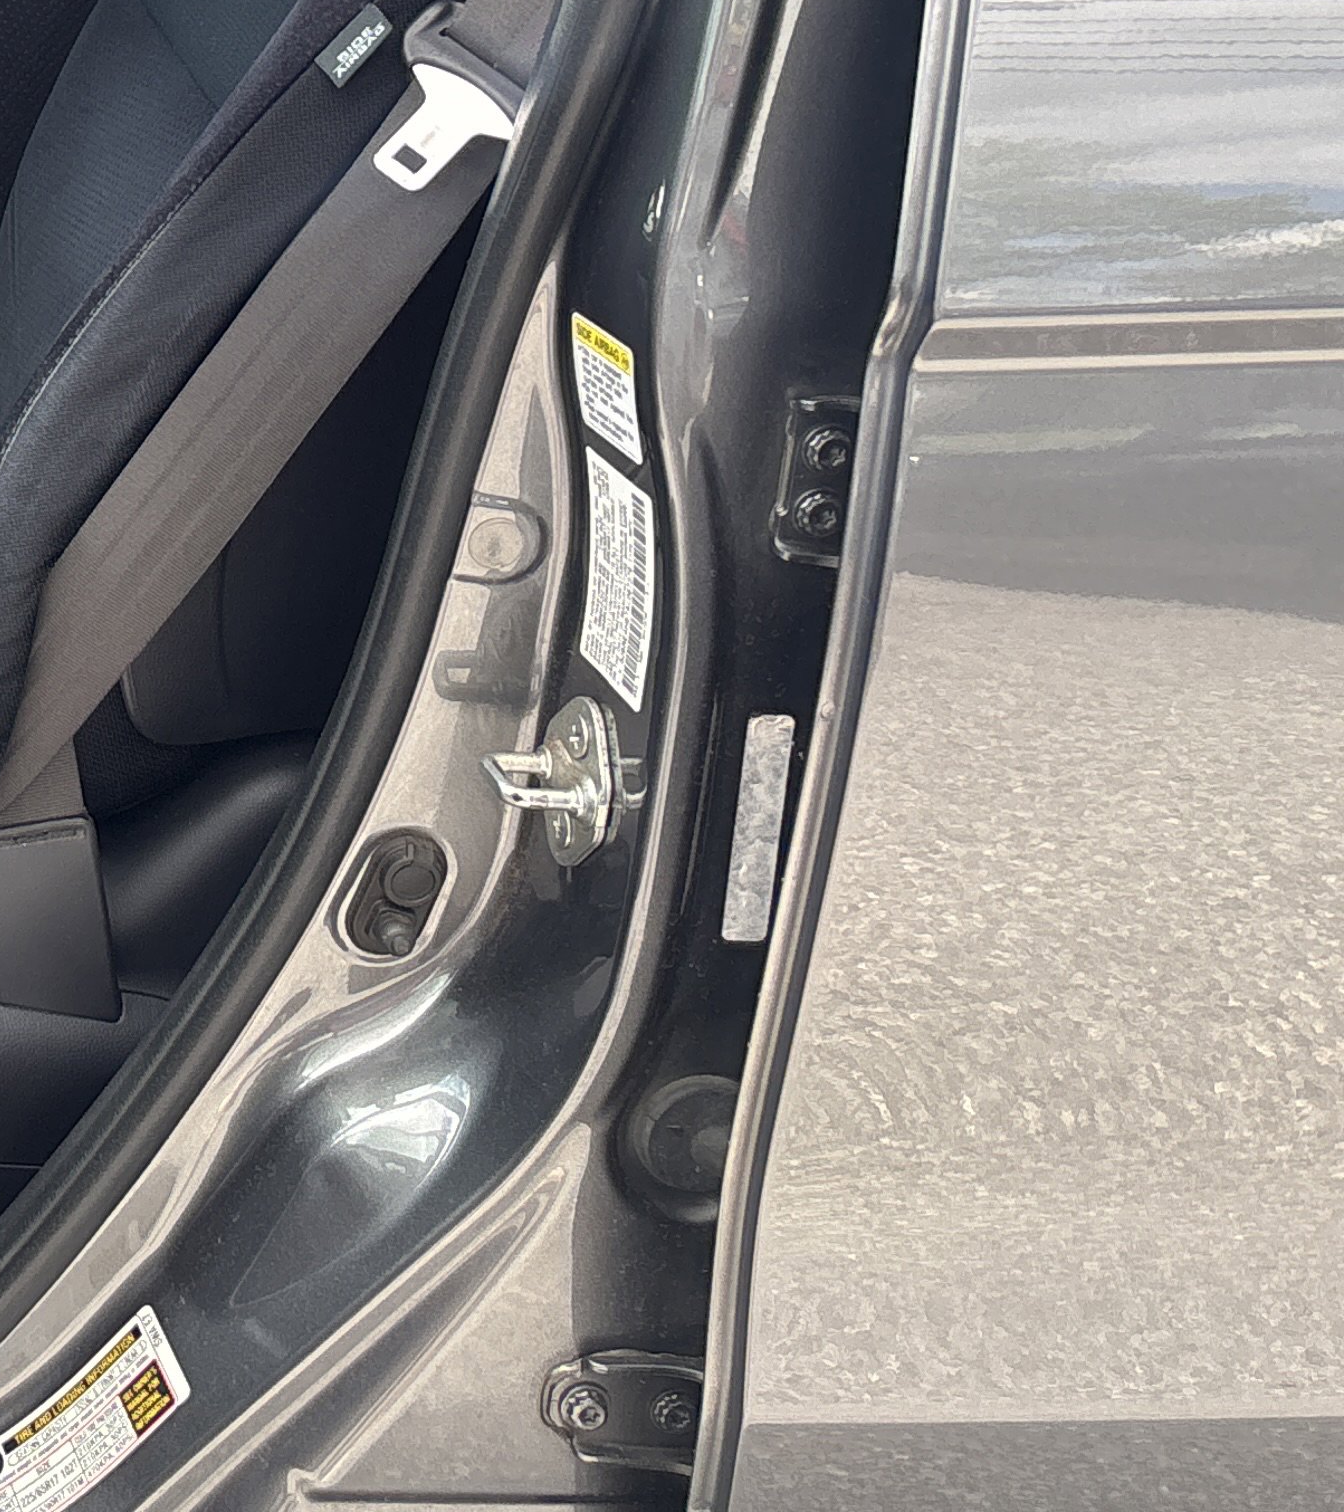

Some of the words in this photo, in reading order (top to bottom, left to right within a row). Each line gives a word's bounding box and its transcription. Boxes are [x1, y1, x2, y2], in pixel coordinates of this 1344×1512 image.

[14, 1424, 35, 1445] TIRE
[33, 1409, 53, 1431] AND
[52, 1380, 86, 1417] LOADING
[85, 1332, 136, 1386] INFORMATION
